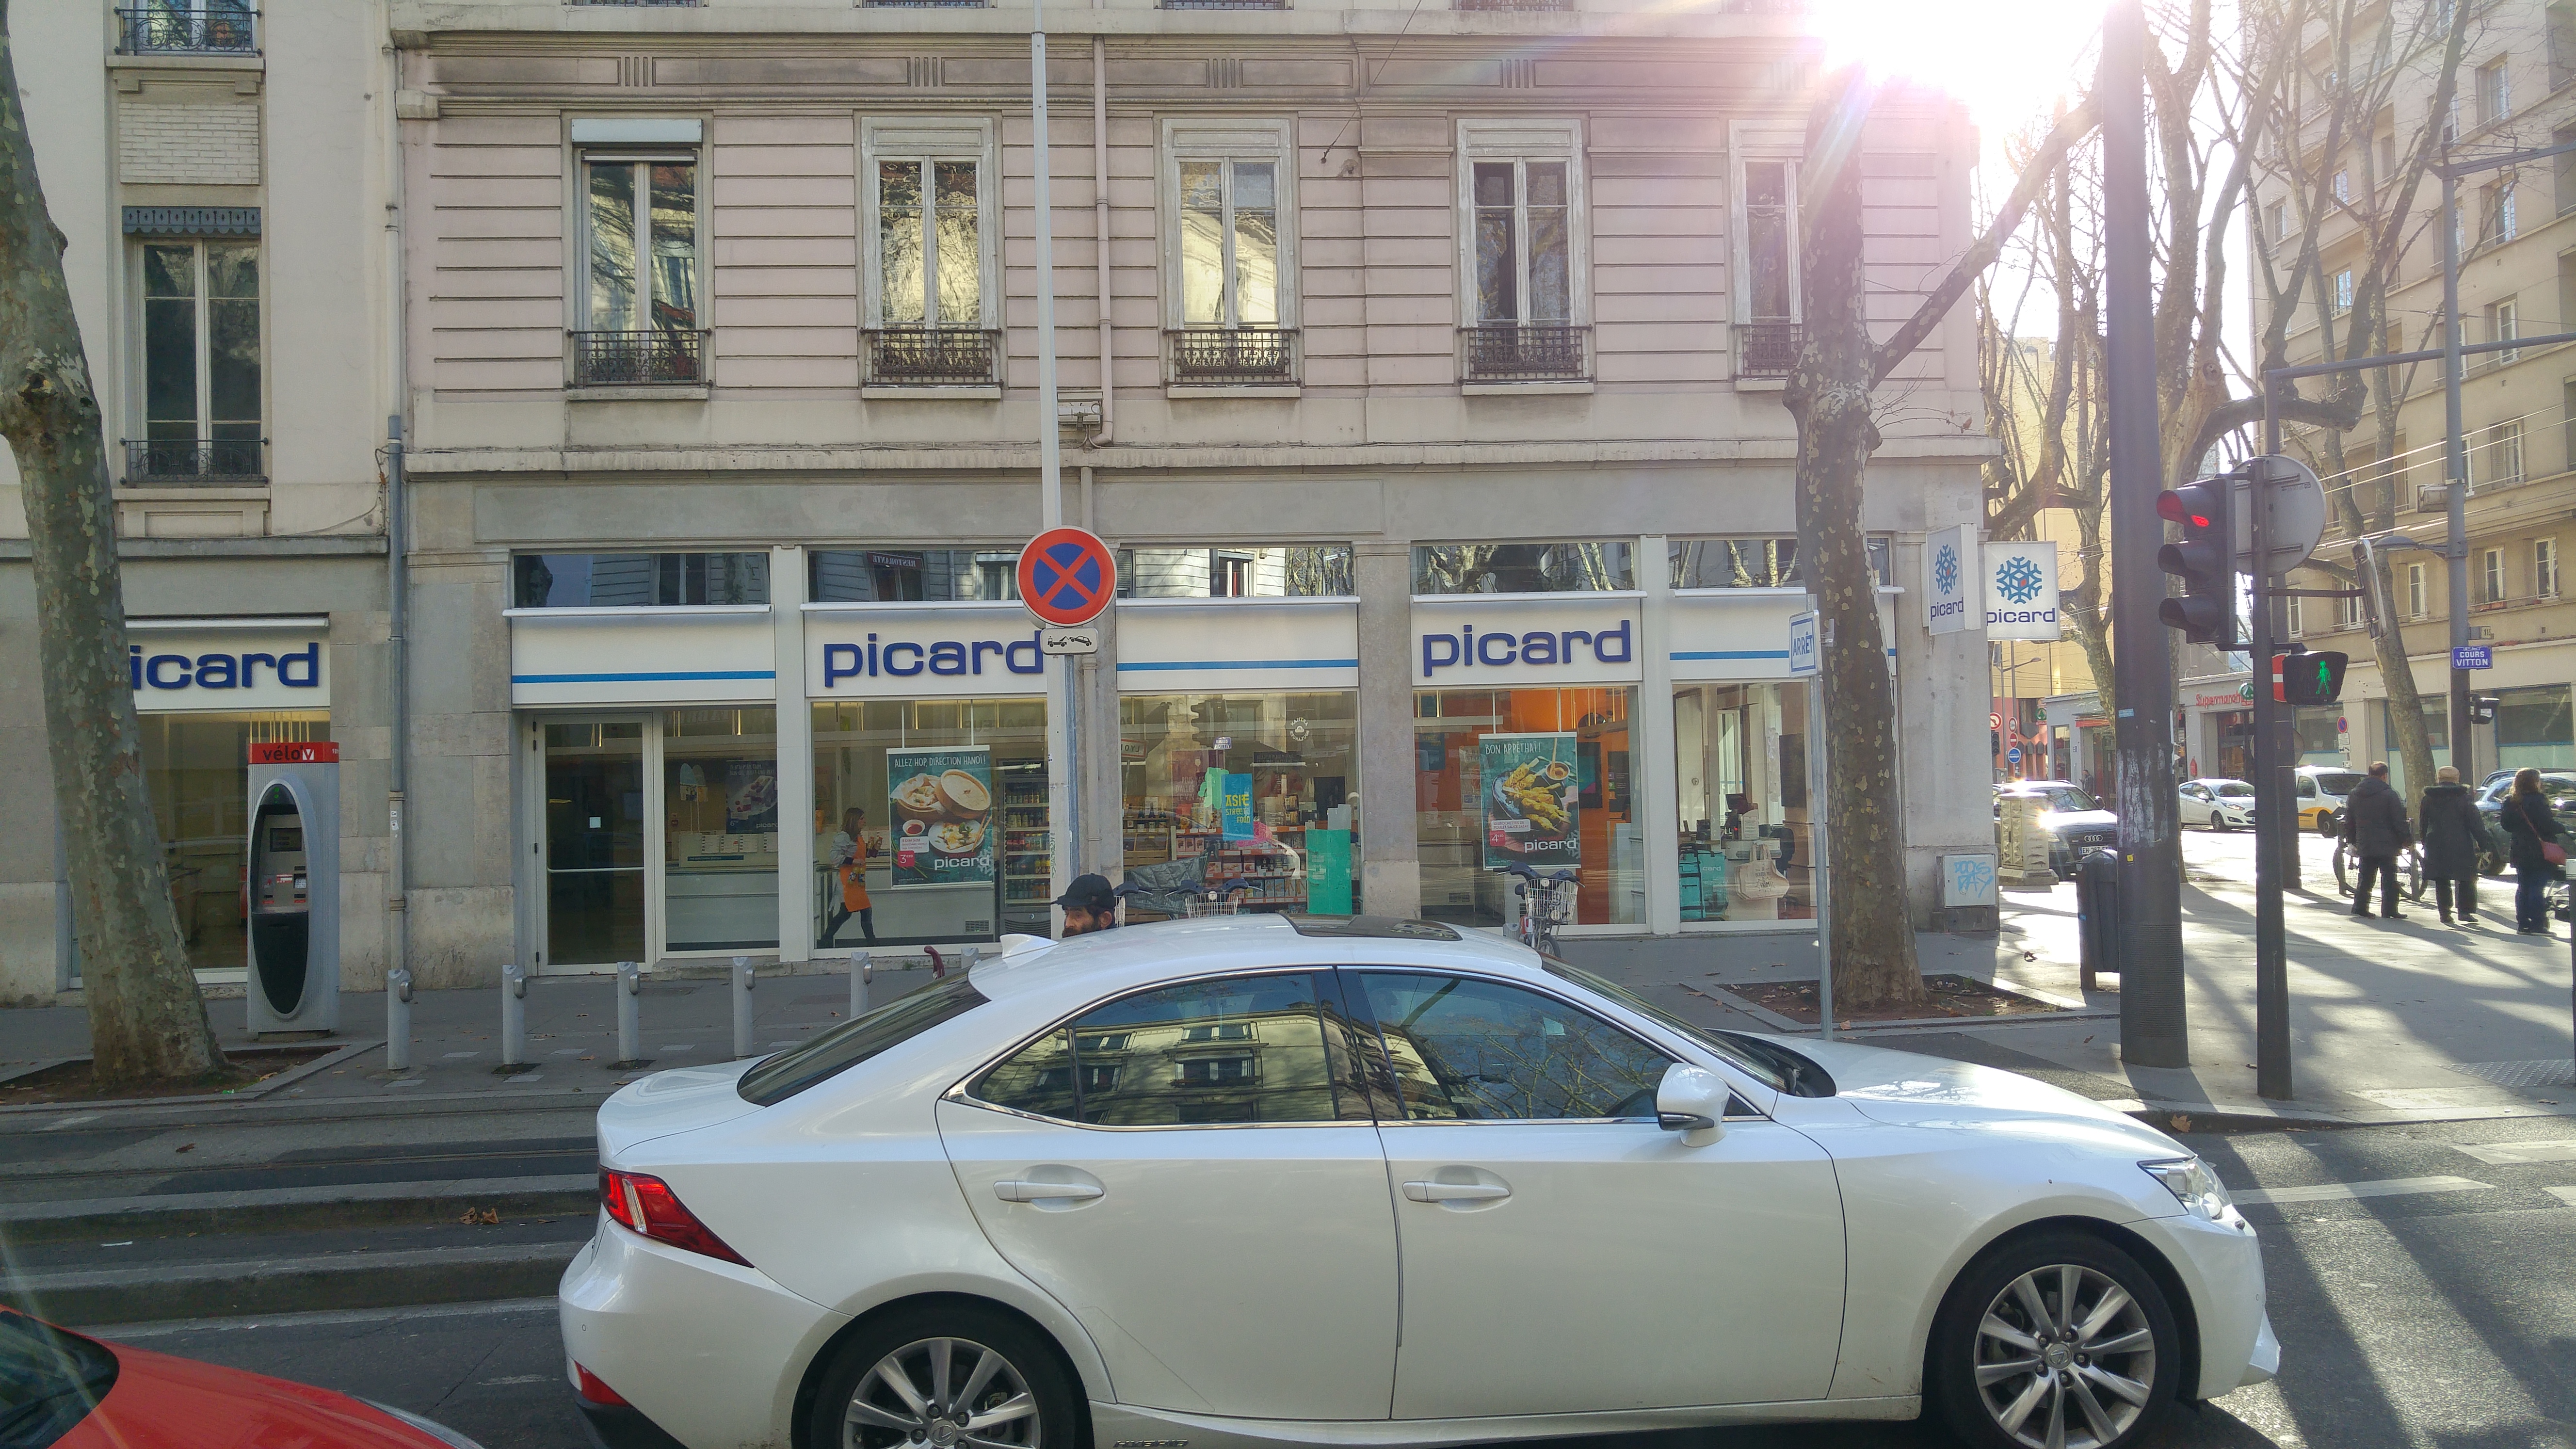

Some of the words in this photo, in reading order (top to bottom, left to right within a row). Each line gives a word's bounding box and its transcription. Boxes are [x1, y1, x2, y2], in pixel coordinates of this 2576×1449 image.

[1931, 599, 1964, 621] picard
[1986, 608, 2055, 626] picard
[1422, 620, 1632, 677] picard
[1792, 631, 1813, 656] ARRÊT
[130, 642, 320, 689] icard
[823, 630, 1044, 688] picard
[2196, 690, 2244, 708] Supermarch
[1485, 744, 1500, 755] BON
[895, 758, 912, 768] ALLEZ
[929, 757, 961, 766] DIRECTION
[1175, 785, 1195, 793] D'ALLER
[1225, 794, 1249, 806] ASIE
[1524, 837, 1577, 853] picard
[934, 854, 990, 870] picard
[1113, 1439, 1189, 1448] HYBRID
